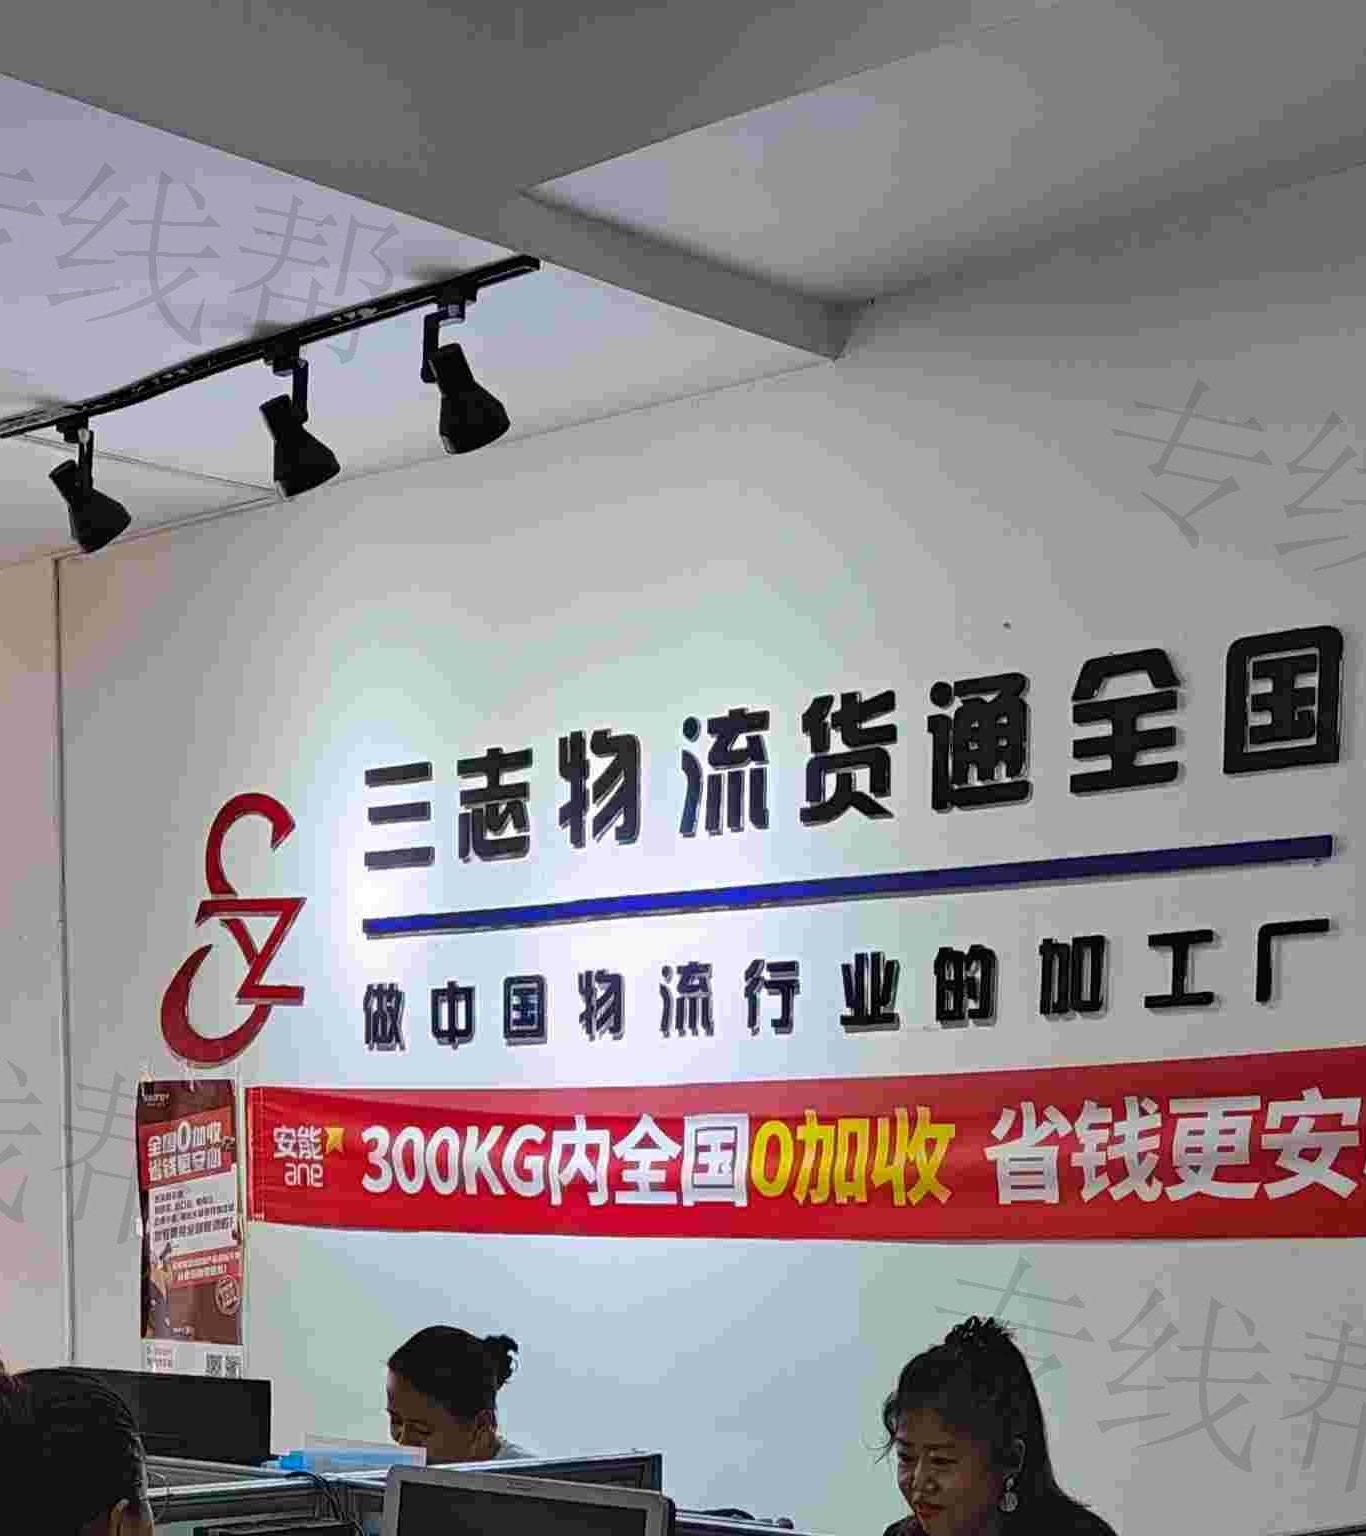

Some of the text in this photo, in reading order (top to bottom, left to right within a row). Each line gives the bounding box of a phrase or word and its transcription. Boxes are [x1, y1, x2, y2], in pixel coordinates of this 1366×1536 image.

[363, 625, 1344, 871] 三志物流货通全国
[363, 918, 1331, 1051] 做中国物流行业的加工厂
[272, 1124, 323, 1160] 安能
[284, 1161, 324, 1188] ane
[361, 1105, 956, 1206] 300KG内全国0加收
